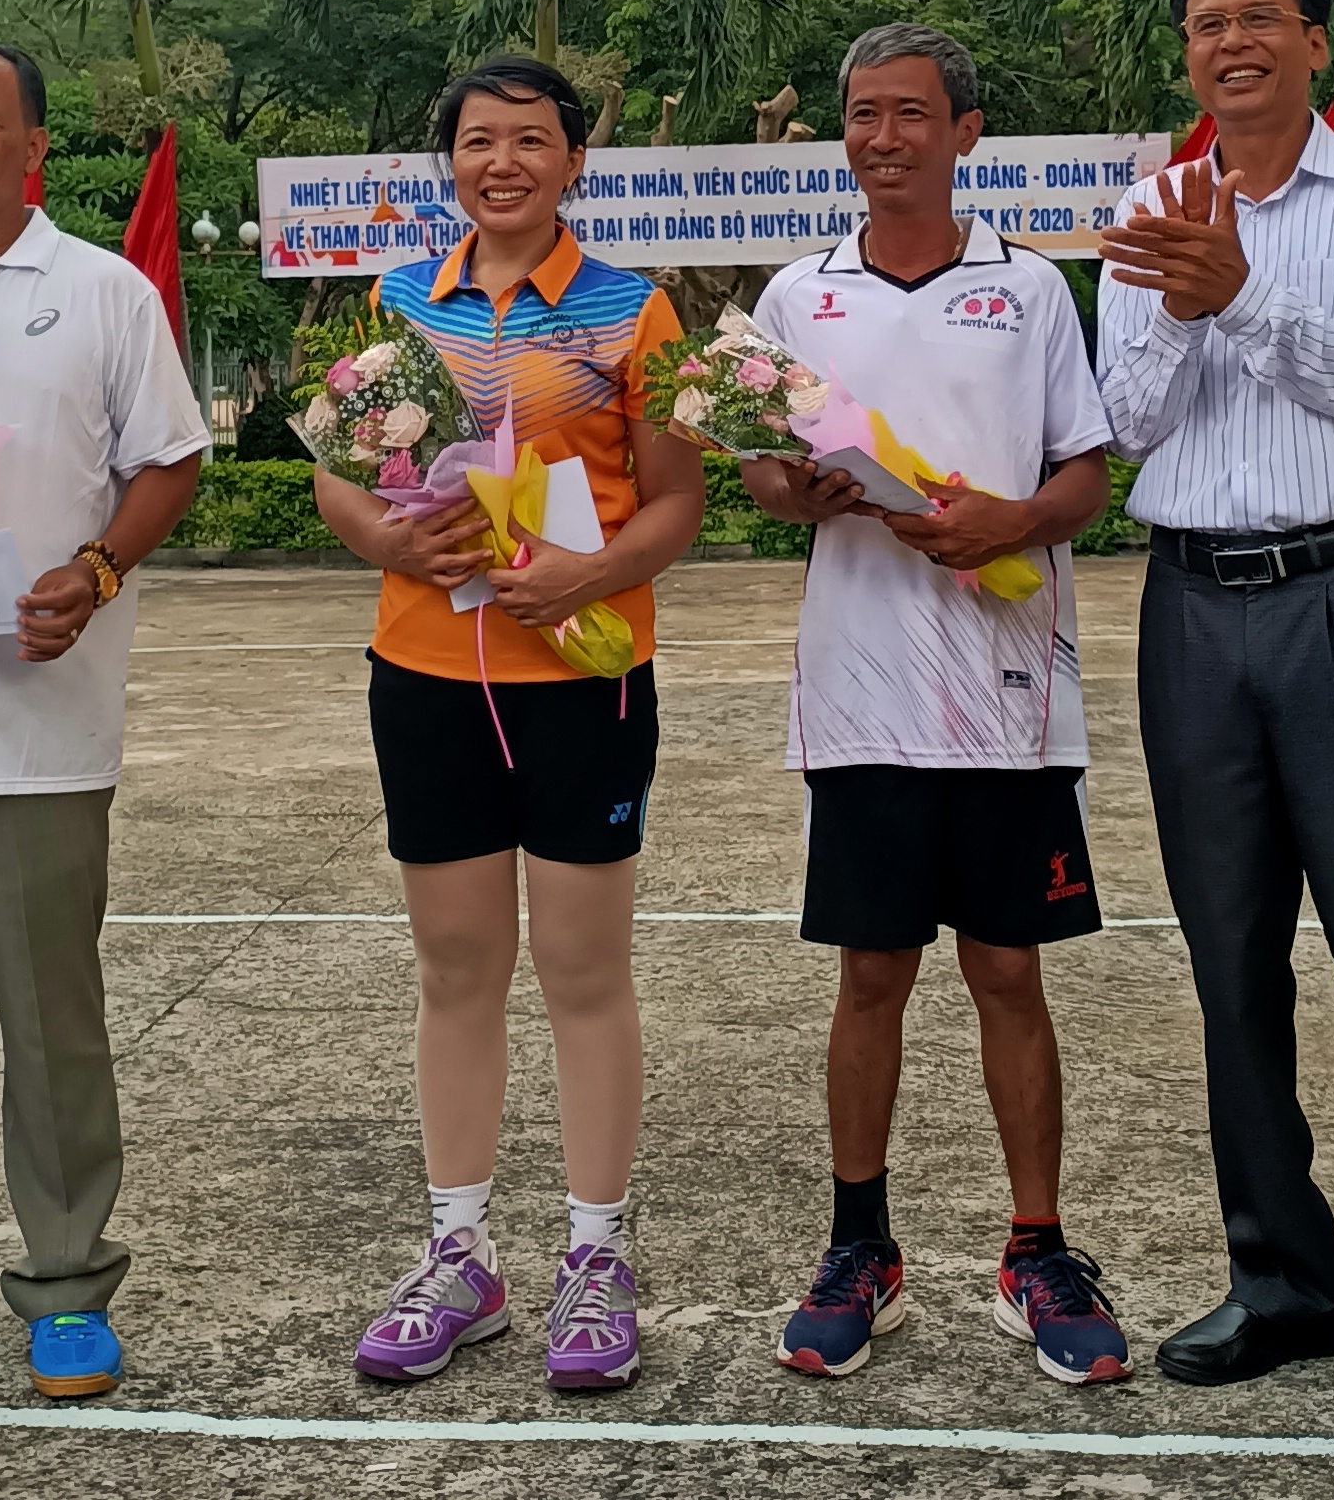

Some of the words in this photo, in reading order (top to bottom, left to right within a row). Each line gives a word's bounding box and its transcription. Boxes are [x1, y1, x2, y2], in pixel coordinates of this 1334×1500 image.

[290, 177, 340, 212] NHIỆT
[346, 176, 381, 210] LIỆT
[387, 175, 433, 204] CHÀO
[577, 170, 626, 200] CÔNG
[631, 167, 689, 200] NHÂN,
[693, 166, 735, 196] VIÊN
[741, 165, 790, 195] CHỨC
[796, 168, 829, 194] LAO
[976, 156, 1027, 189] ĐẢNG
[1045, 158, 1097, 188] ĐOÀN
[1102, 152, 1137, 187] THỂ
[311, 224, 359, 250] THAM
[366, 221, 391, 253] DỰ
[395, 218, 424, 253] HỘI
[593, 217, 624, 247] ĐẠI
[629, 212, 659, 246] HỘI
[665, 207, 715, 240] ĐẢNG
[721, 209, 745, 244] BỘ
[751, 208, 811, 243] HUYỆN
[1000, 203, 1024, 232] KỲ
[1029, 207, 1073, 232] 2020
